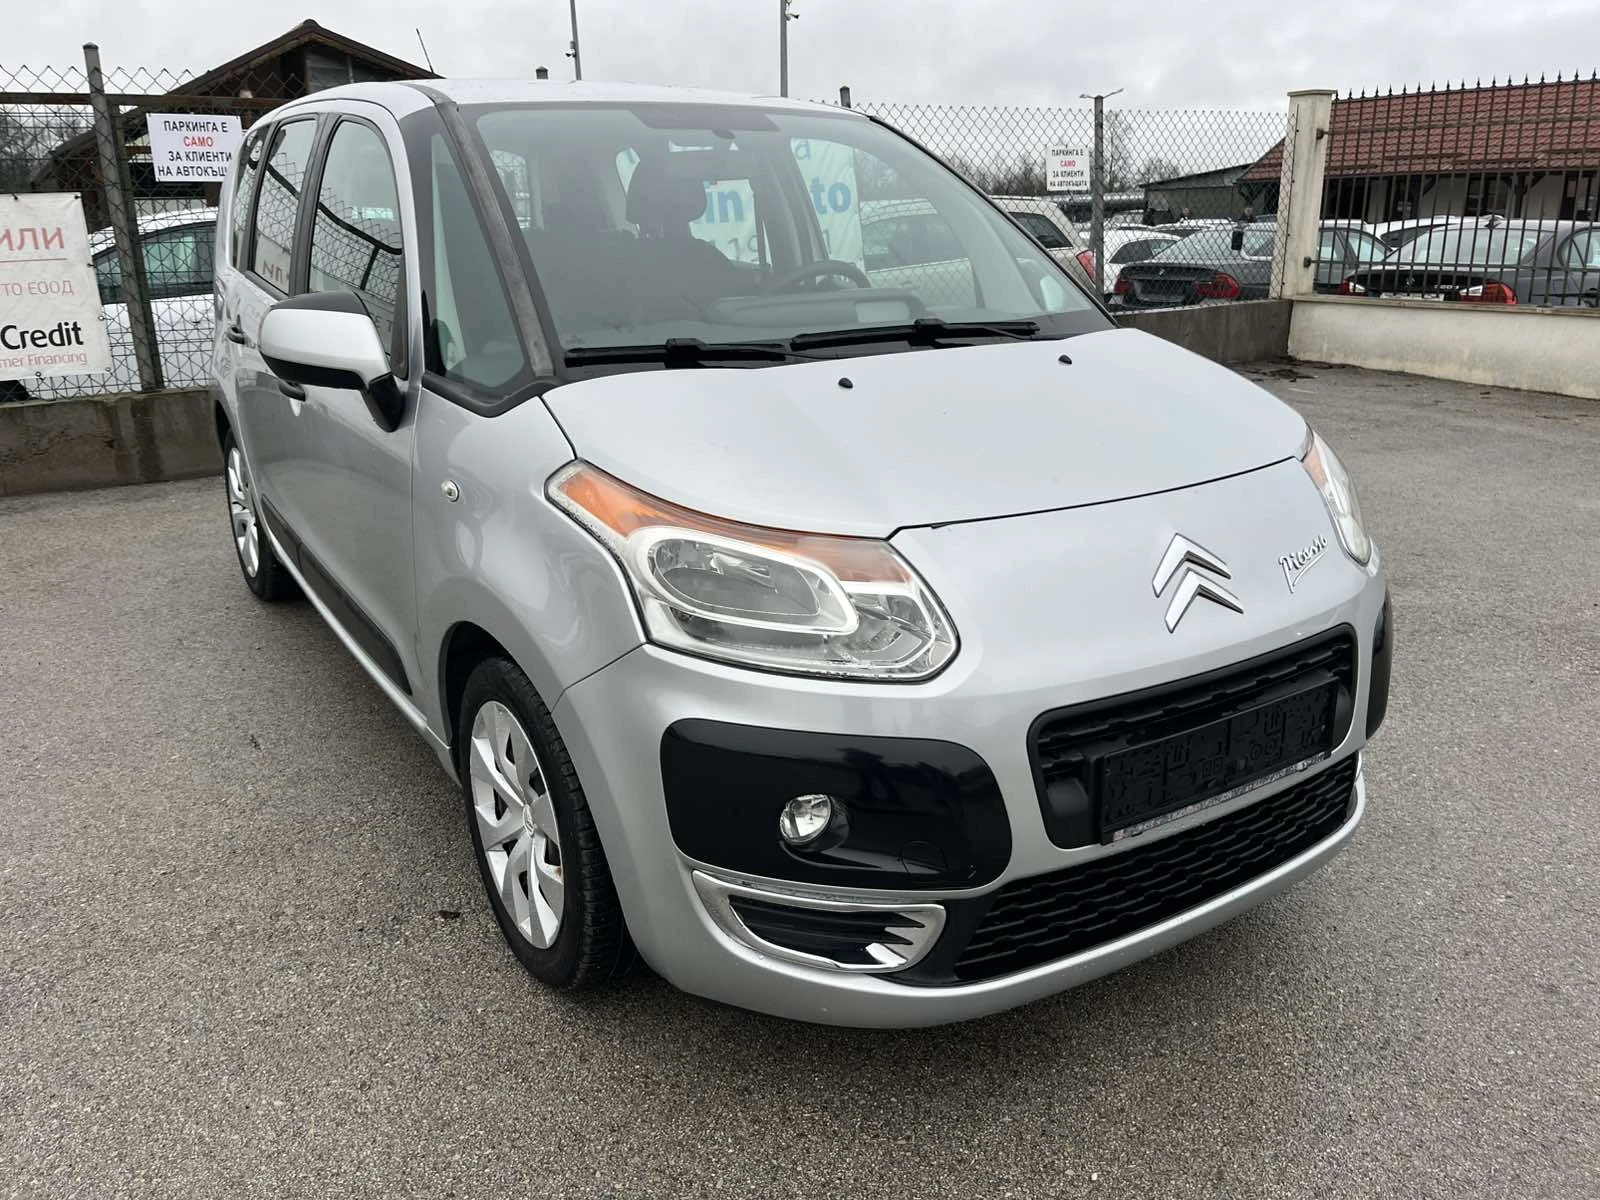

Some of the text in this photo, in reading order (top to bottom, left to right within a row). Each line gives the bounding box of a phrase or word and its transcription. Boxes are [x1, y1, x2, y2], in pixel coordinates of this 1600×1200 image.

[164, 120, 229, 133] ПАРКИНГА Е
[183, 135, 214, 148] САМО
[168, 150, 233, 163] ЗА КЛИЕНТИ
[158, 165, 173, 177] НА
[28, 280, 75, 296] ЕООД
[0, 321, 84, 350] Credit
[27, 352, 88, 368] Financing
